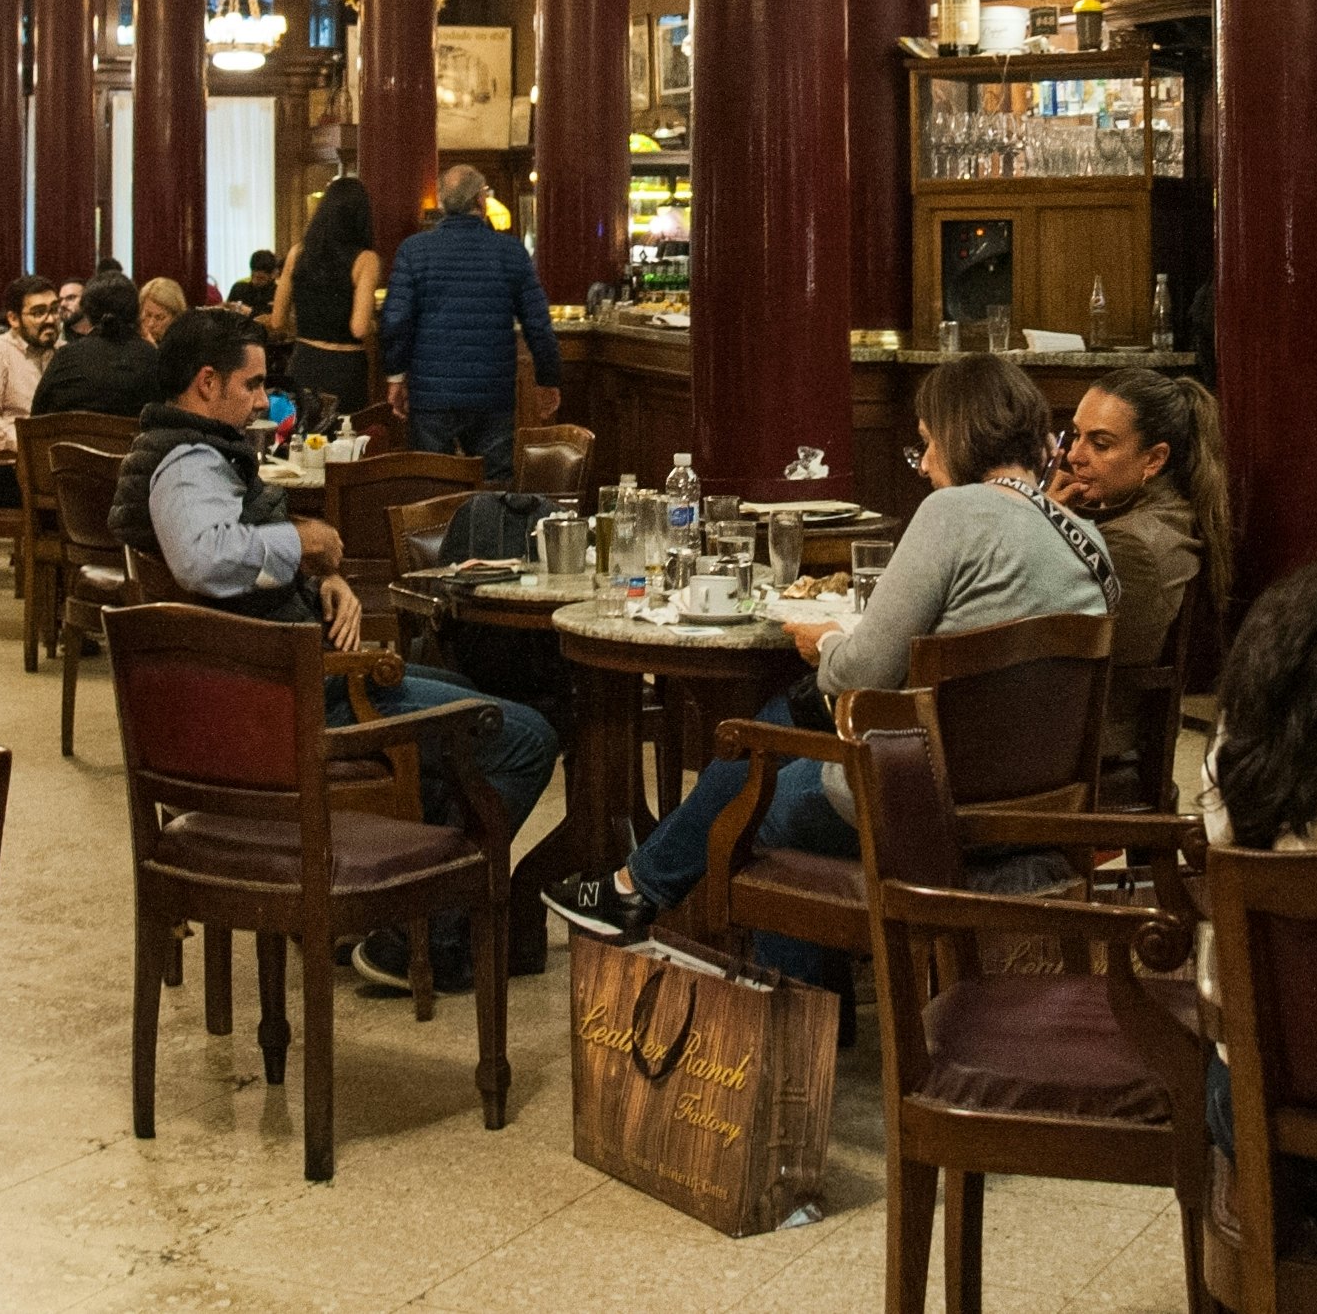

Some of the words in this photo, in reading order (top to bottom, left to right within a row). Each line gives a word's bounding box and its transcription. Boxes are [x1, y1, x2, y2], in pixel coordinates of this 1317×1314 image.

[578, 881, 599, 907] N
[676, 1031, 754, 1090] Ranch
[674, 1092, 741, 1148] Factory
